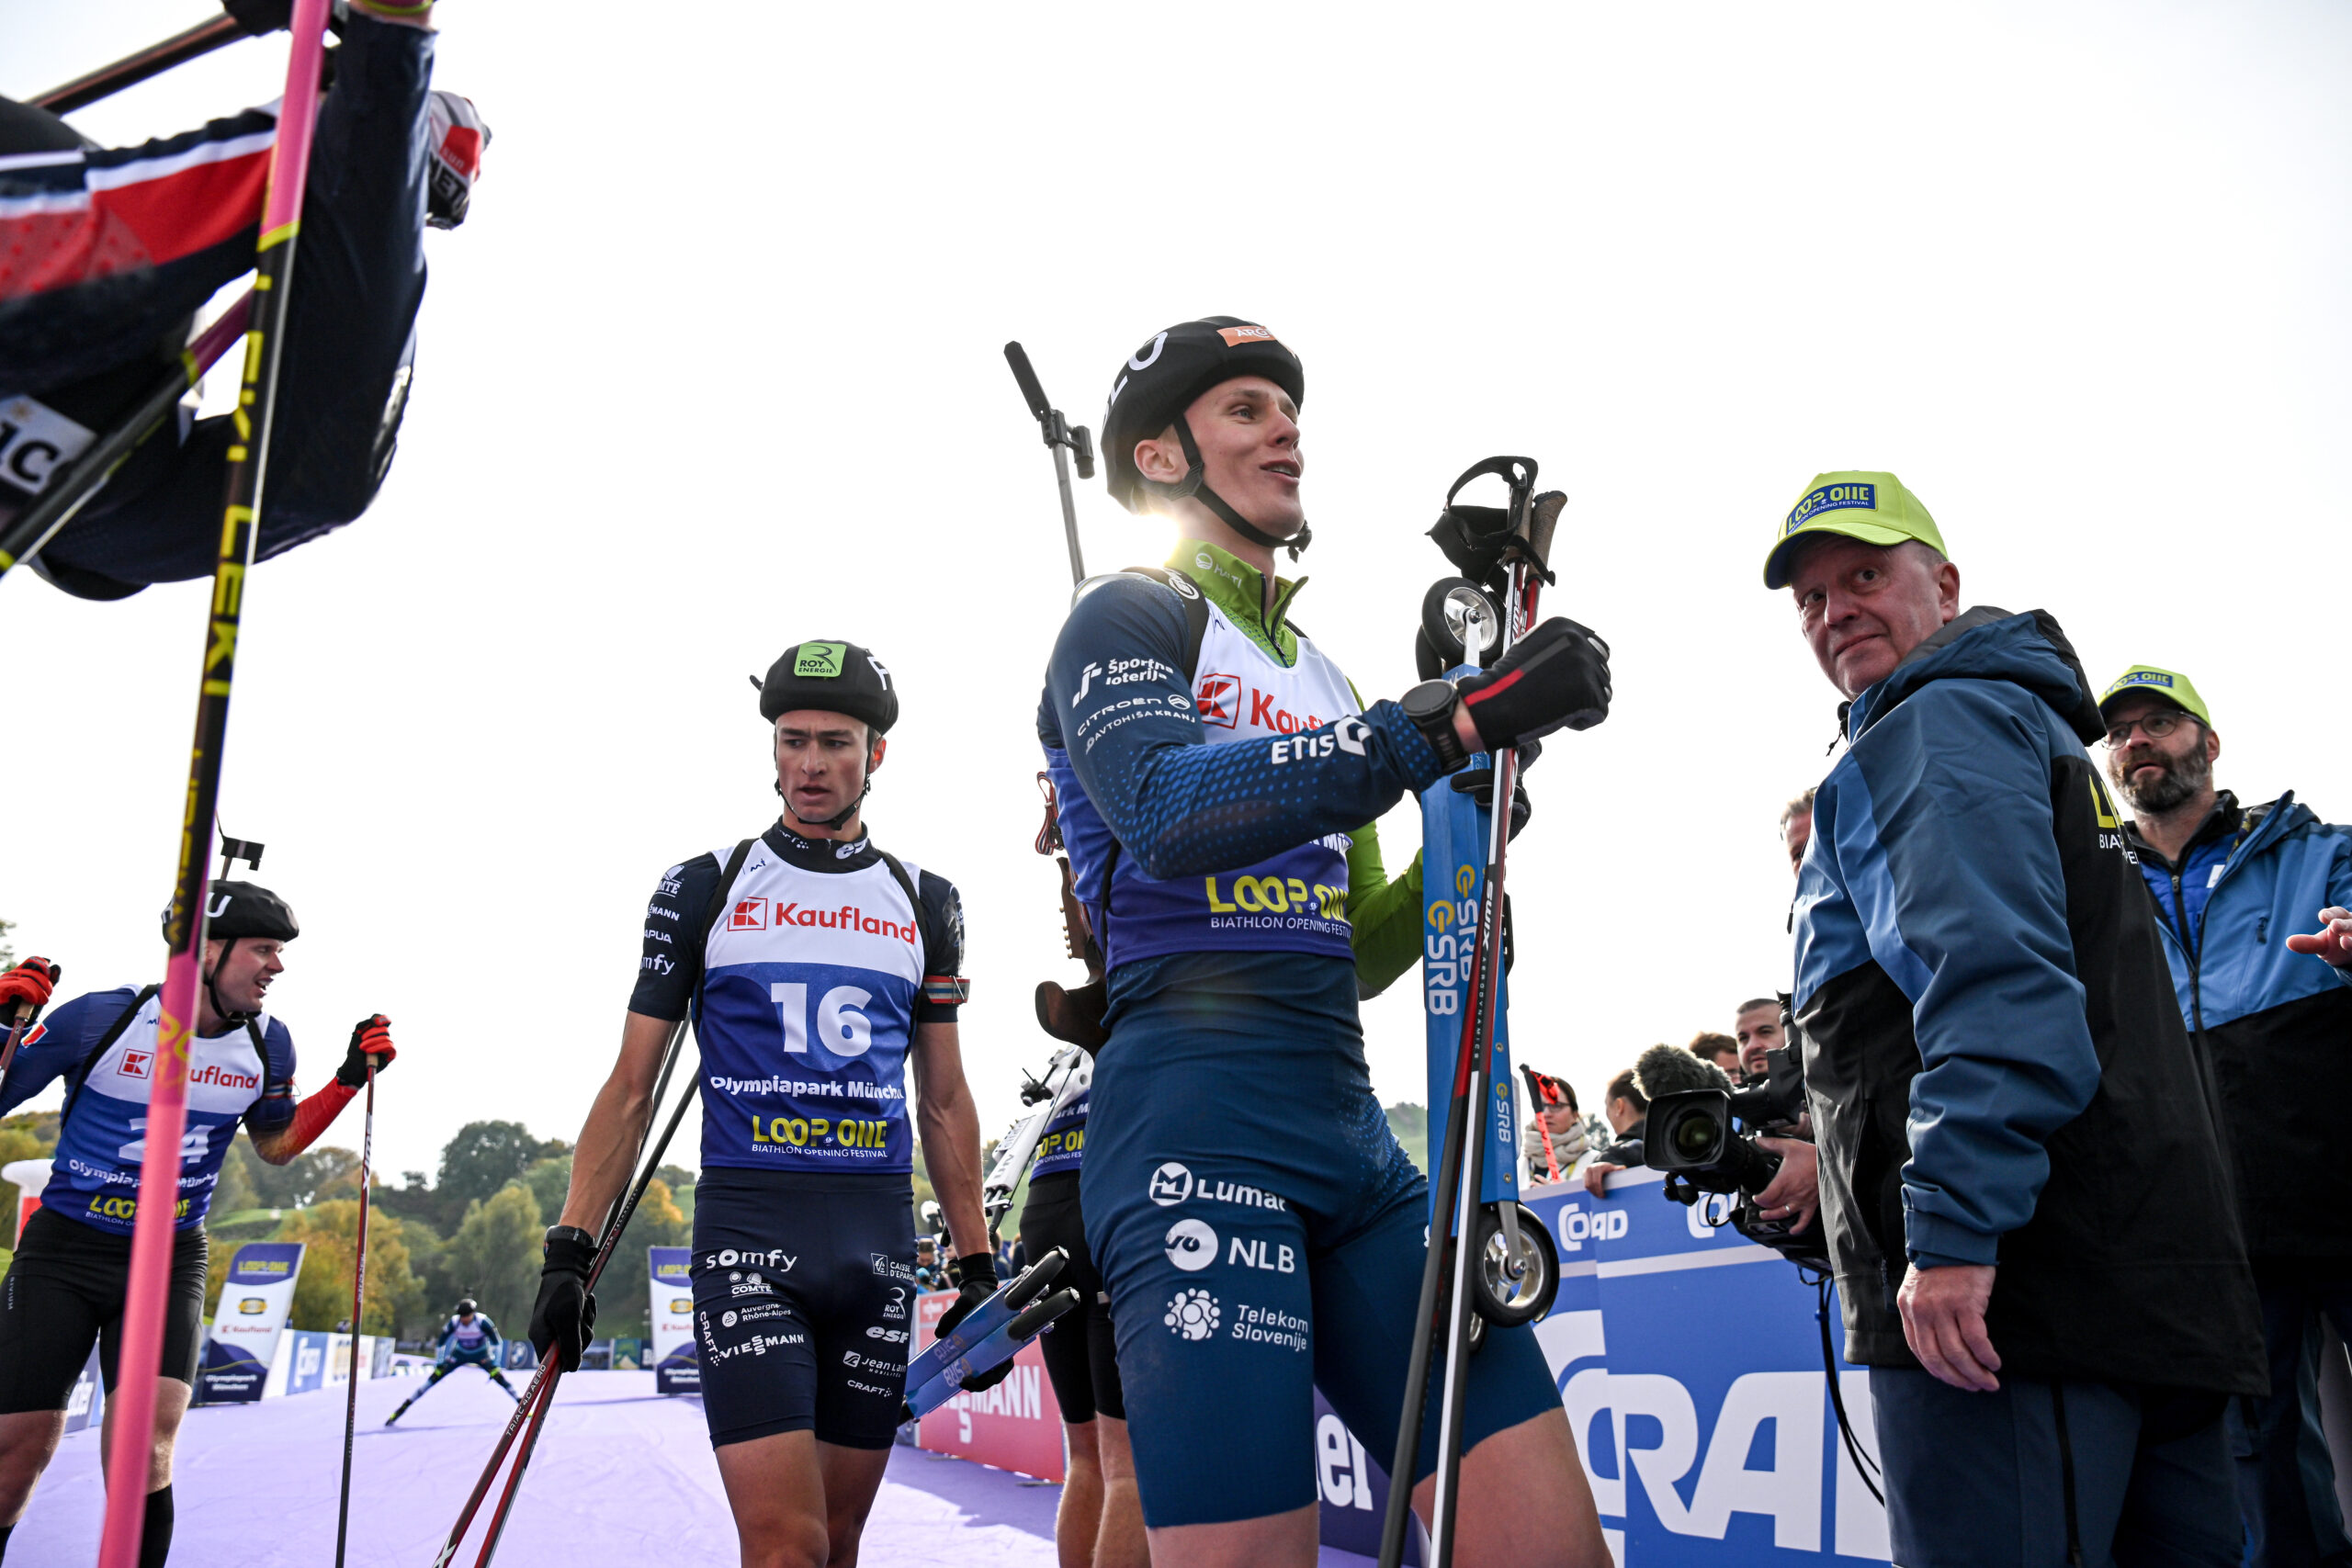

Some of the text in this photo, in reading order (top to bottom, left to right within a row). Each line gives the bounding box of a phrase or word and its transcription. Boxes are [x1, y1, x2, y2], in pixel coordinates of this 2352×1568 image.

[1809, 502, 1838, 515] OPENING
[202, 504, 256, 698] LEKI
[799, 660, 825, 668] ROY
[1108, 659, 1174, 674] Športna
[1105, 668, 1168, 685] loterija
[1155, 710, 1196, 723] KRANJ
[1272, 734, 1335, 764] ETIS
[1205, 875, 1308, 913] LOOP
[775, 902, 917, 945] Kaufland
[1482, 879, 1494, 951] SWIX
[644, 930, 673, 944] APUA
[1211, 917, 1351, 938] BIATHLON OPENING FESTIV
[639, 953, 675, 976] mfy
[1427, 933, 1458, 1016] SRB
[1474, 956, 1487, 1058] AERODYNAMICS
[771, 982, 873, 1057] 16
[189, 1065, 260, 1089] ufland
[710, 1075, 843, 1098] Olympiapark
[752, 1114, 888, 1148] LOOP ONE
[1496, 1100, 1511, 1144] SRB
[752, 1144, 888, 1158] BIATHLON OPENING FESTIVAL
[85, 1212, 124, 1226] BIATHLON
[707, 1248, 797, 1272] somfy
[1227, 1236, 1295, 1274] NLB
[890, 1261, 910, 1273] CAISSE
[742, 1310, 792, 1322] Rhône-Alpes
[885, 1304, 899, 1314] ROY
[1238, 1303, 1308, 1334] Telekom
[699, 1311, 718, 1353] CRAFT
[866, 1325, 910, 1344] esf
[1231, 1323, 1308, 1353] Slovenije
[862, 1358, 890, 1371] Jean
[847, 1380, 886, 1396] CRAFT
[506, 1405, 525, 1437] TRIAC
[531, 1364, 547, 1393] AERO
